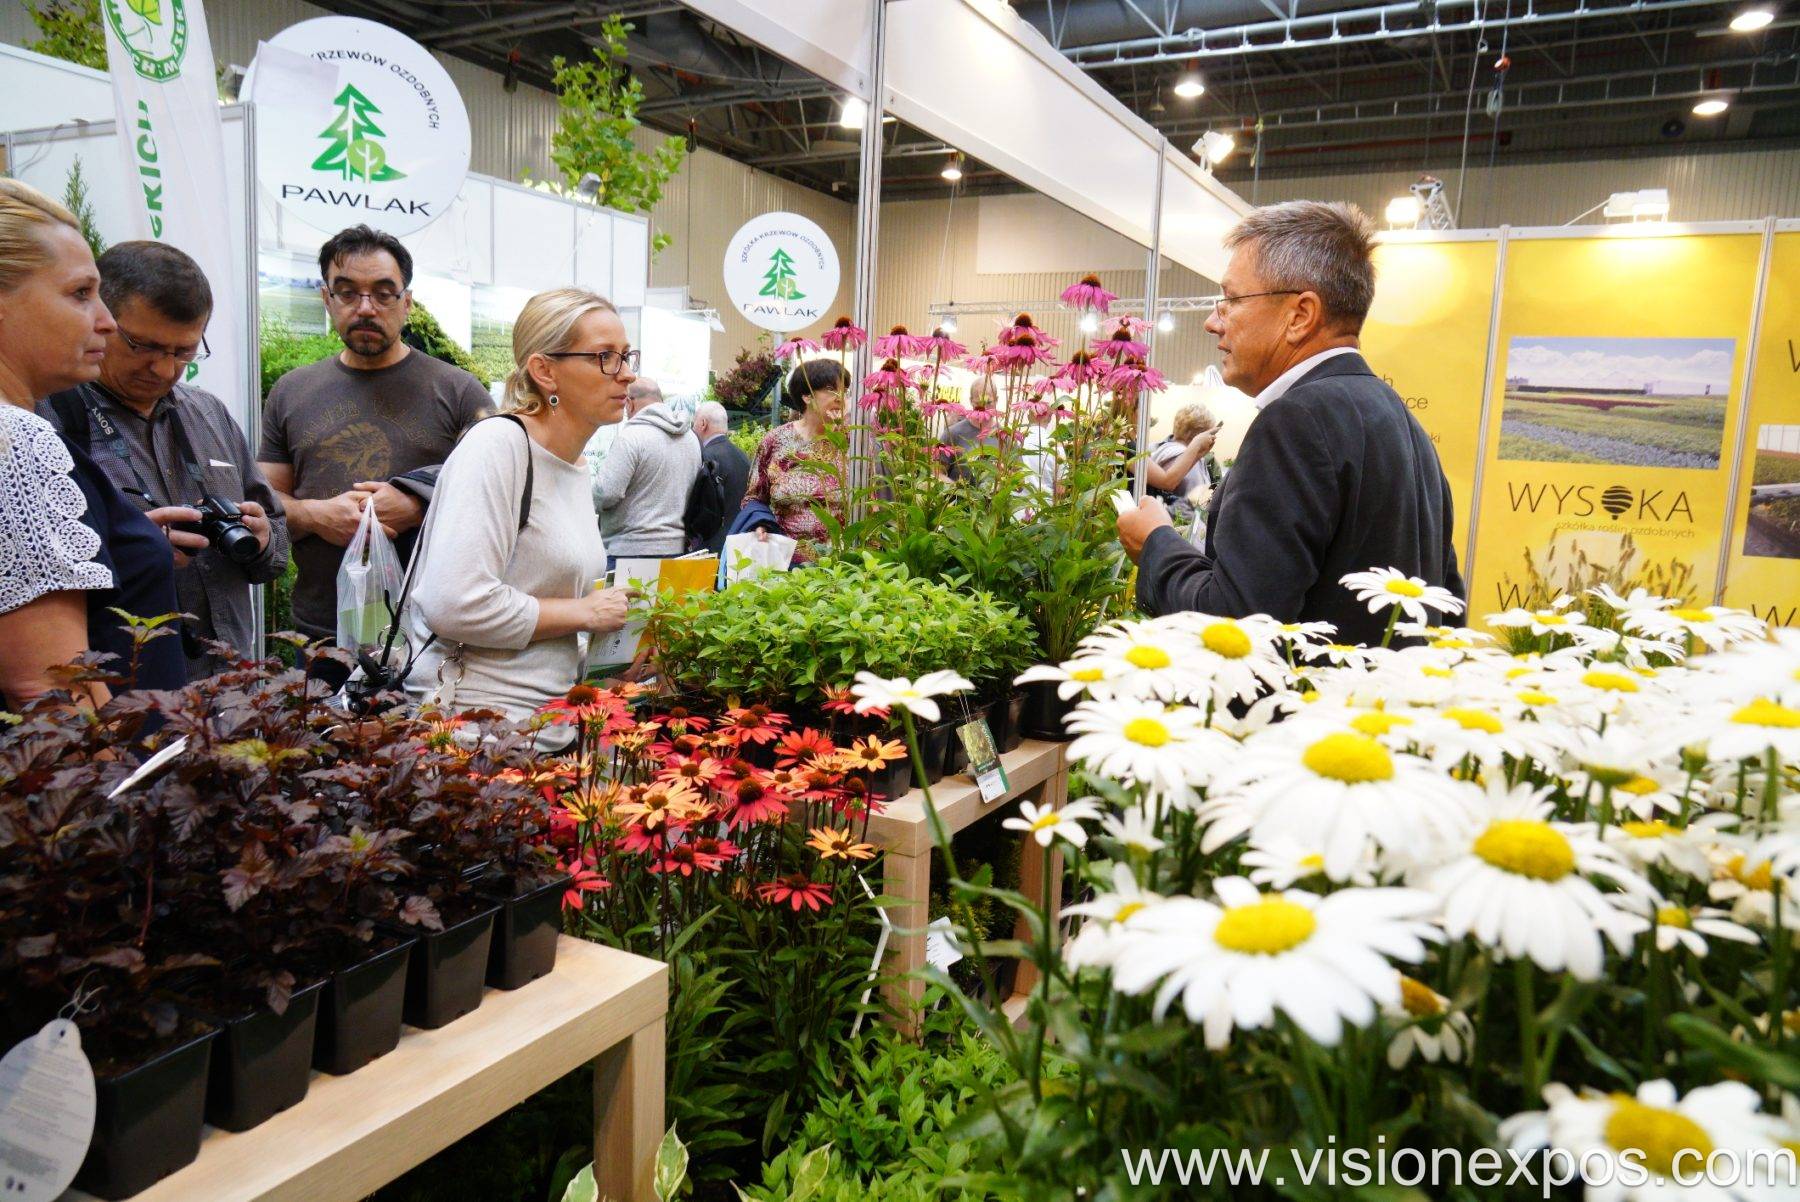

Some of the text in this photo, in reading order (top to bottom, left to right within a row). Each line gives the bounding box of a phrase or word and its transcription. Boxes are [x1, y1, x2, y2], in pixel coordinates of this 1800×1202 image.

[311, 49, 440, 130] RZEWÓW OZDOBNYCH
[282, 184, 431, 217] PAWLAK
[743, 303, 818, 317] PAWLAK
[91, 406, 115, 435] SONY
[1508, 481, 1694, 523] WYSOKA
[1630, 526, 1696, 539] ozdobnych
